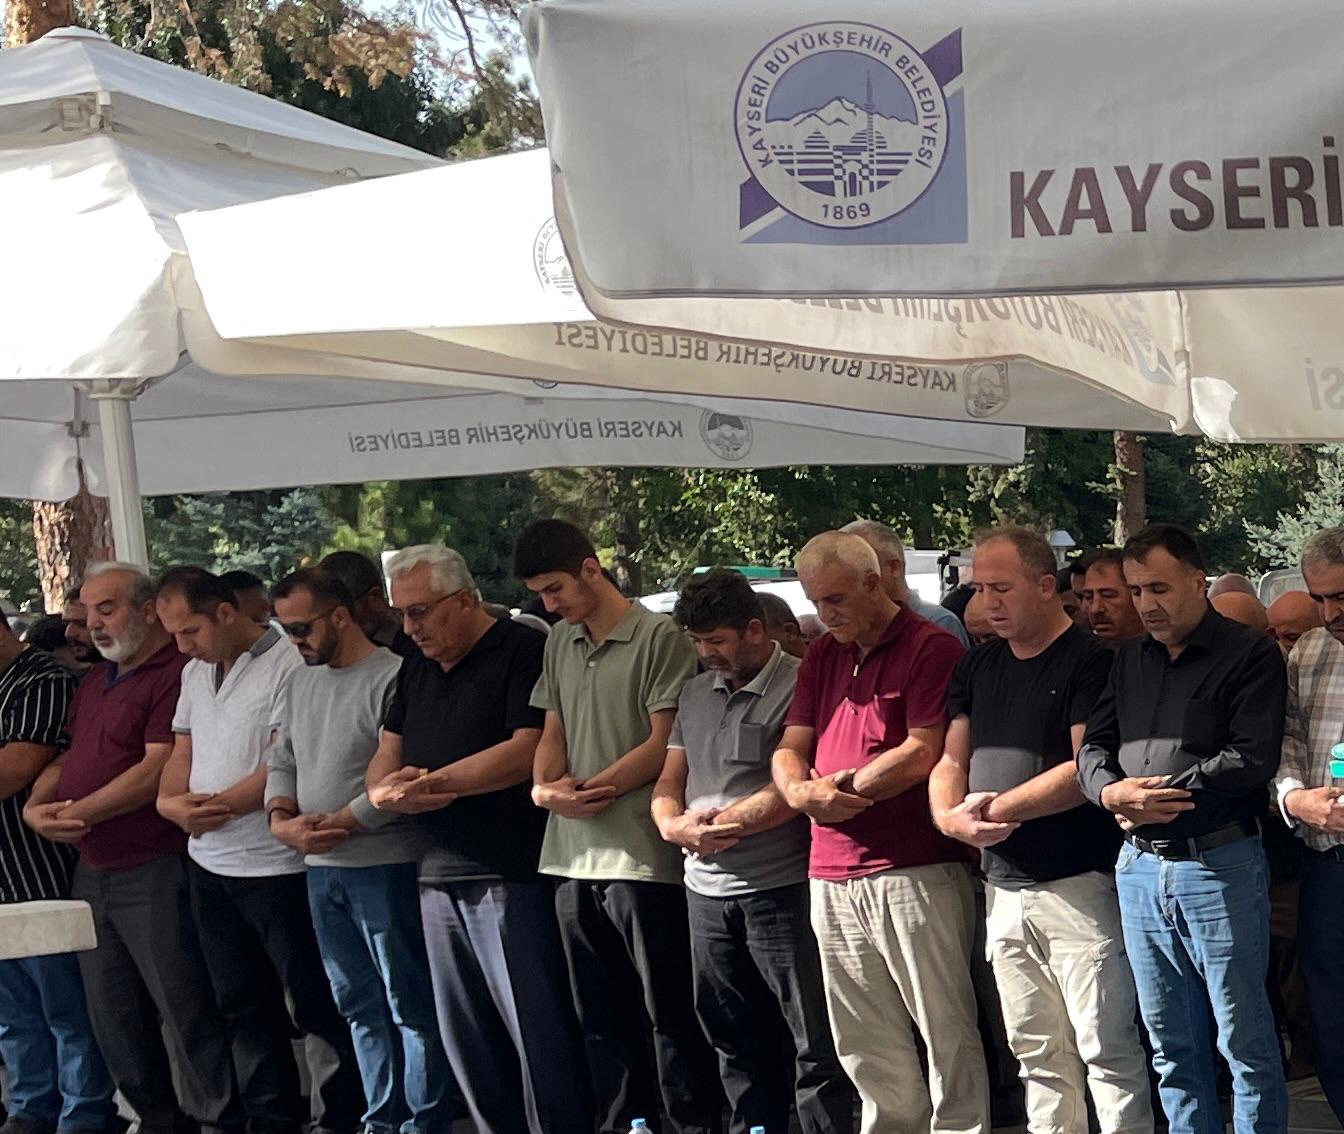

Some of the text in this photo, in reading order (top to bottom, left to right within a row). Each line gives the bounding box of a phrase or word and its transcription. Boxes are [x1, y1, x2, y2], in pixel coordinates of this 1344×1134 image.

[764, 30, 893, 76] BÜYÜKŞEHİR
[1008, 135, 1344, 239] KAYSERİ
[821, 202, 871, 220] 1869
